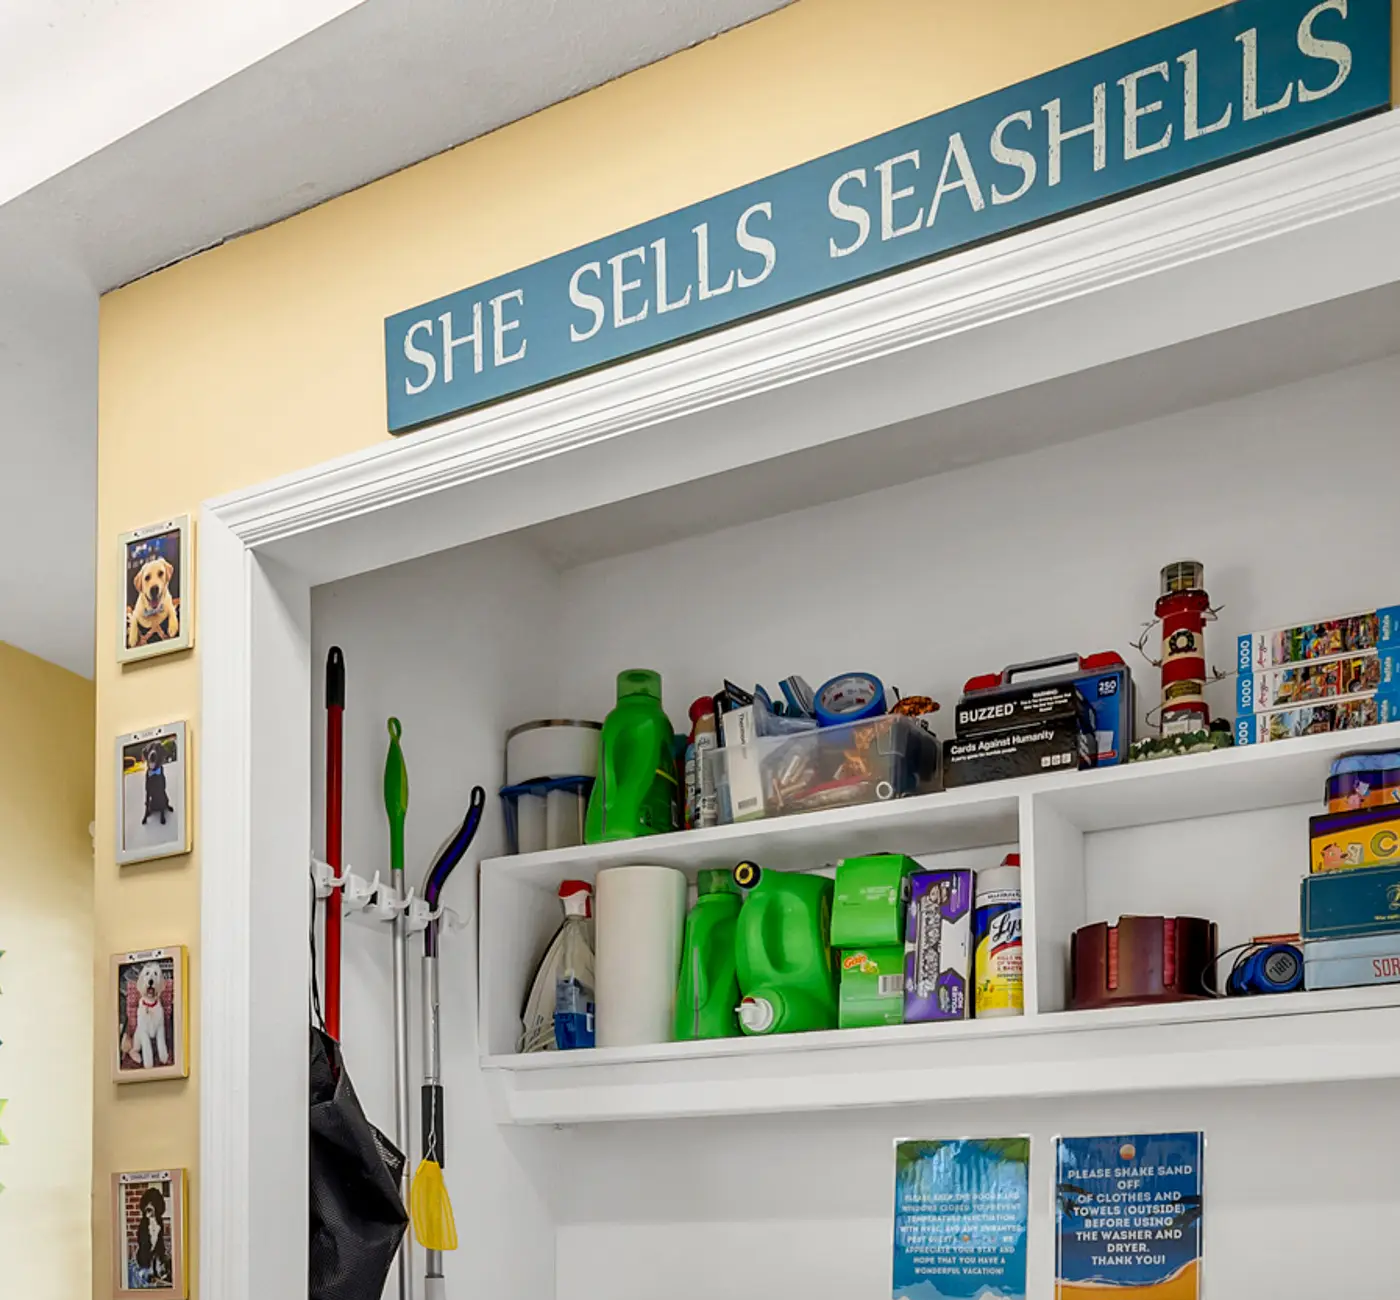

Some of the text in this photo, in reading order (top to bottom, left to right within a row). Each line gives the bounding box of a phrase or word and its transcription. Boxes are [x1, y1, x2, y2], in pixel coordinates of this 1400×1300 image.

[403, 0, 1353, 395] SHE SELLS SEASHELLS
[1240, 640, 1250, 669] 1000
[1099, 680, 1117, 691] 250
[1241, 679, 1251, 708] 1000
[959, 703, 1014, 724] BUZZED
[1239, 721, 1248, 746] 000
[950, 730, 1055, 755] Cards Against Humanity
[1269, 956, 1292, 977] JBL
[1373, 958, 1400, 978] SOR
[1067, 1165, 1192, 1179] PLEASE SHAKE SAND
[1117, 1180, 1140, 1190] OFF
[1077, 1191, 1182, 1204] OF CLOTHES AND
[1073, 1204, 1185, 1216] TOWELS (OUTSIDE)
[1085, 1217, 1173, 1228] BEFORE USING
[1076, 1229, 1182, 1241] THE WASHER AND
[1107, 1243, 1150, 1253] DRYER.
[1091, 1254, 1165, 1265] THANK YOU!
